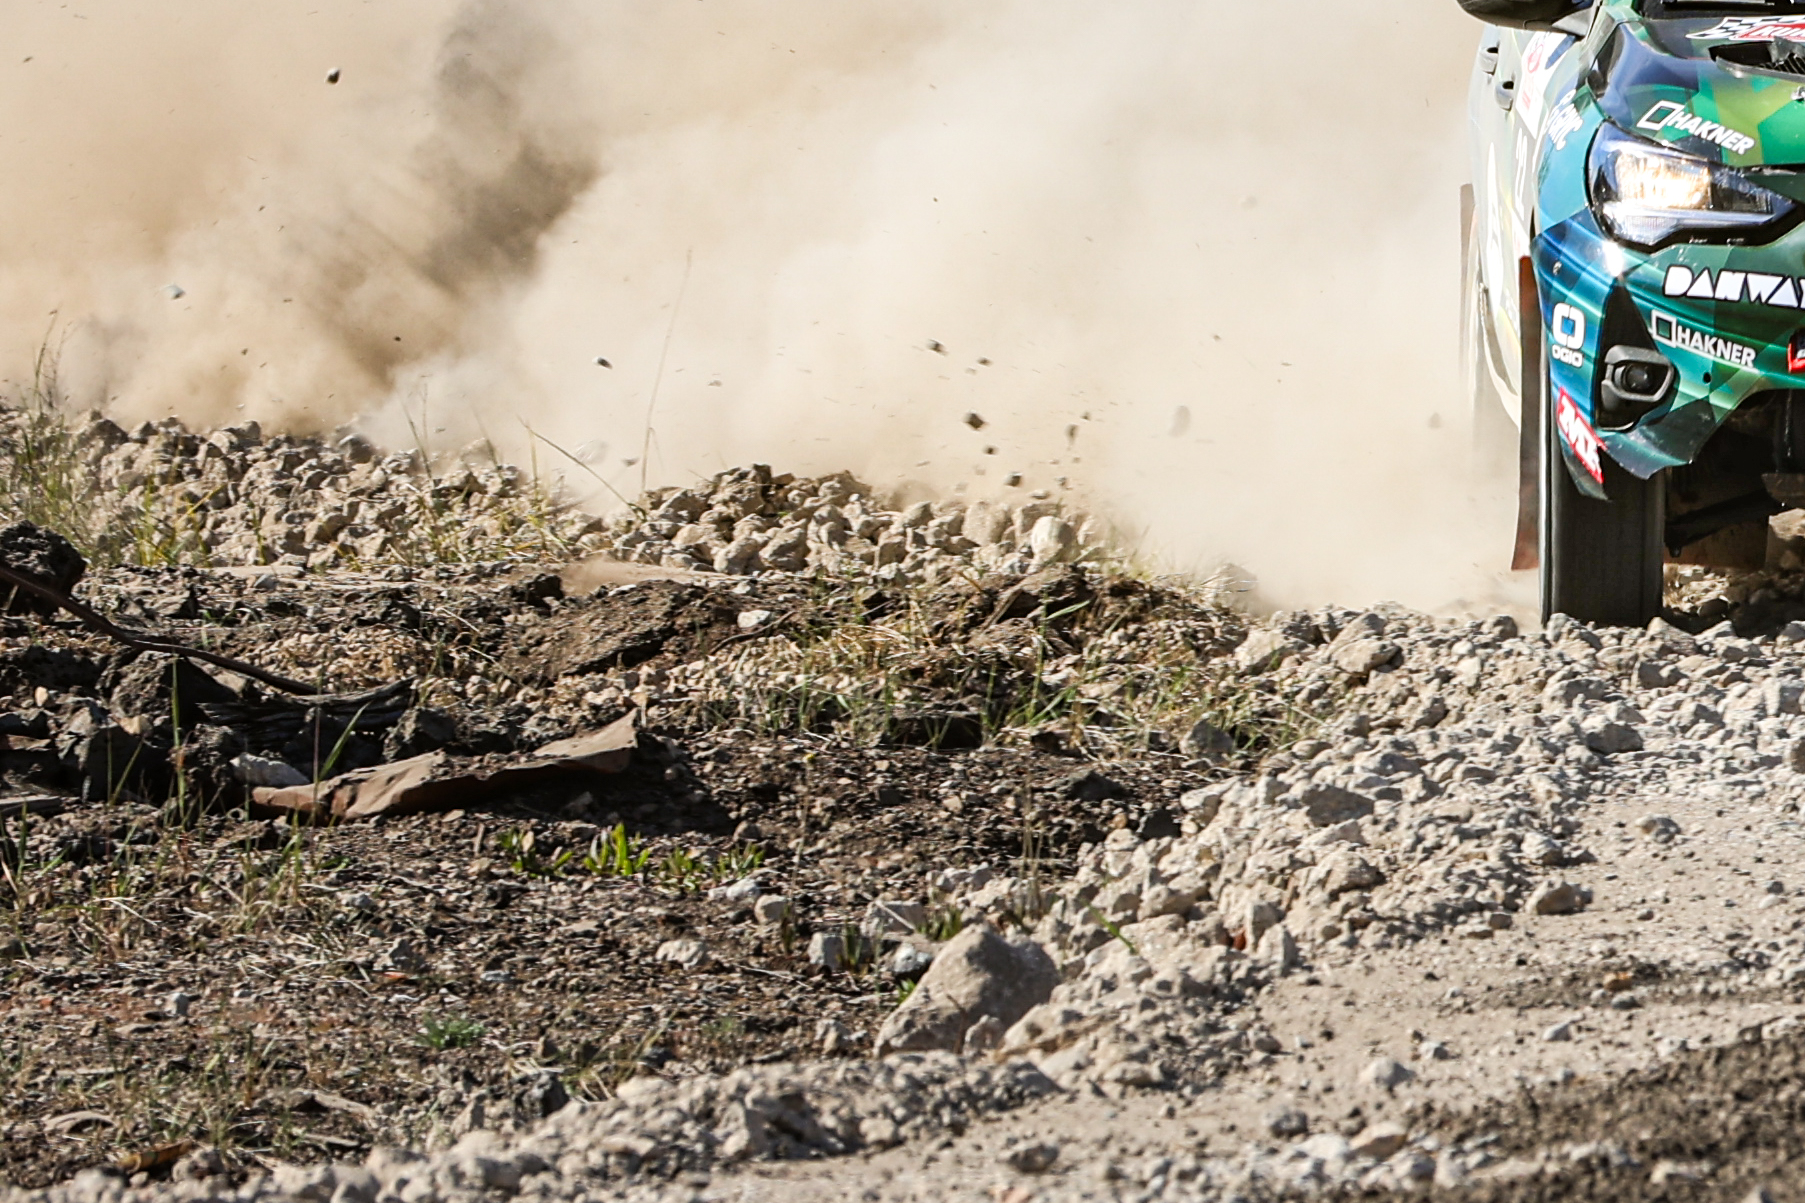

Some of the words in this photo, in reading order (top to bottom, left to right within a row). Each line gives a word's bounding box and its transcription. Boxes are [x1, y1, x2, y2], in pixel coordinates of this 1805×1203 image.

[1667, 111, 1756, 155] HAKNER
[1552, 344, 1584, 368] OGIO
[1677, 326, 1757, 368] HAKNER
